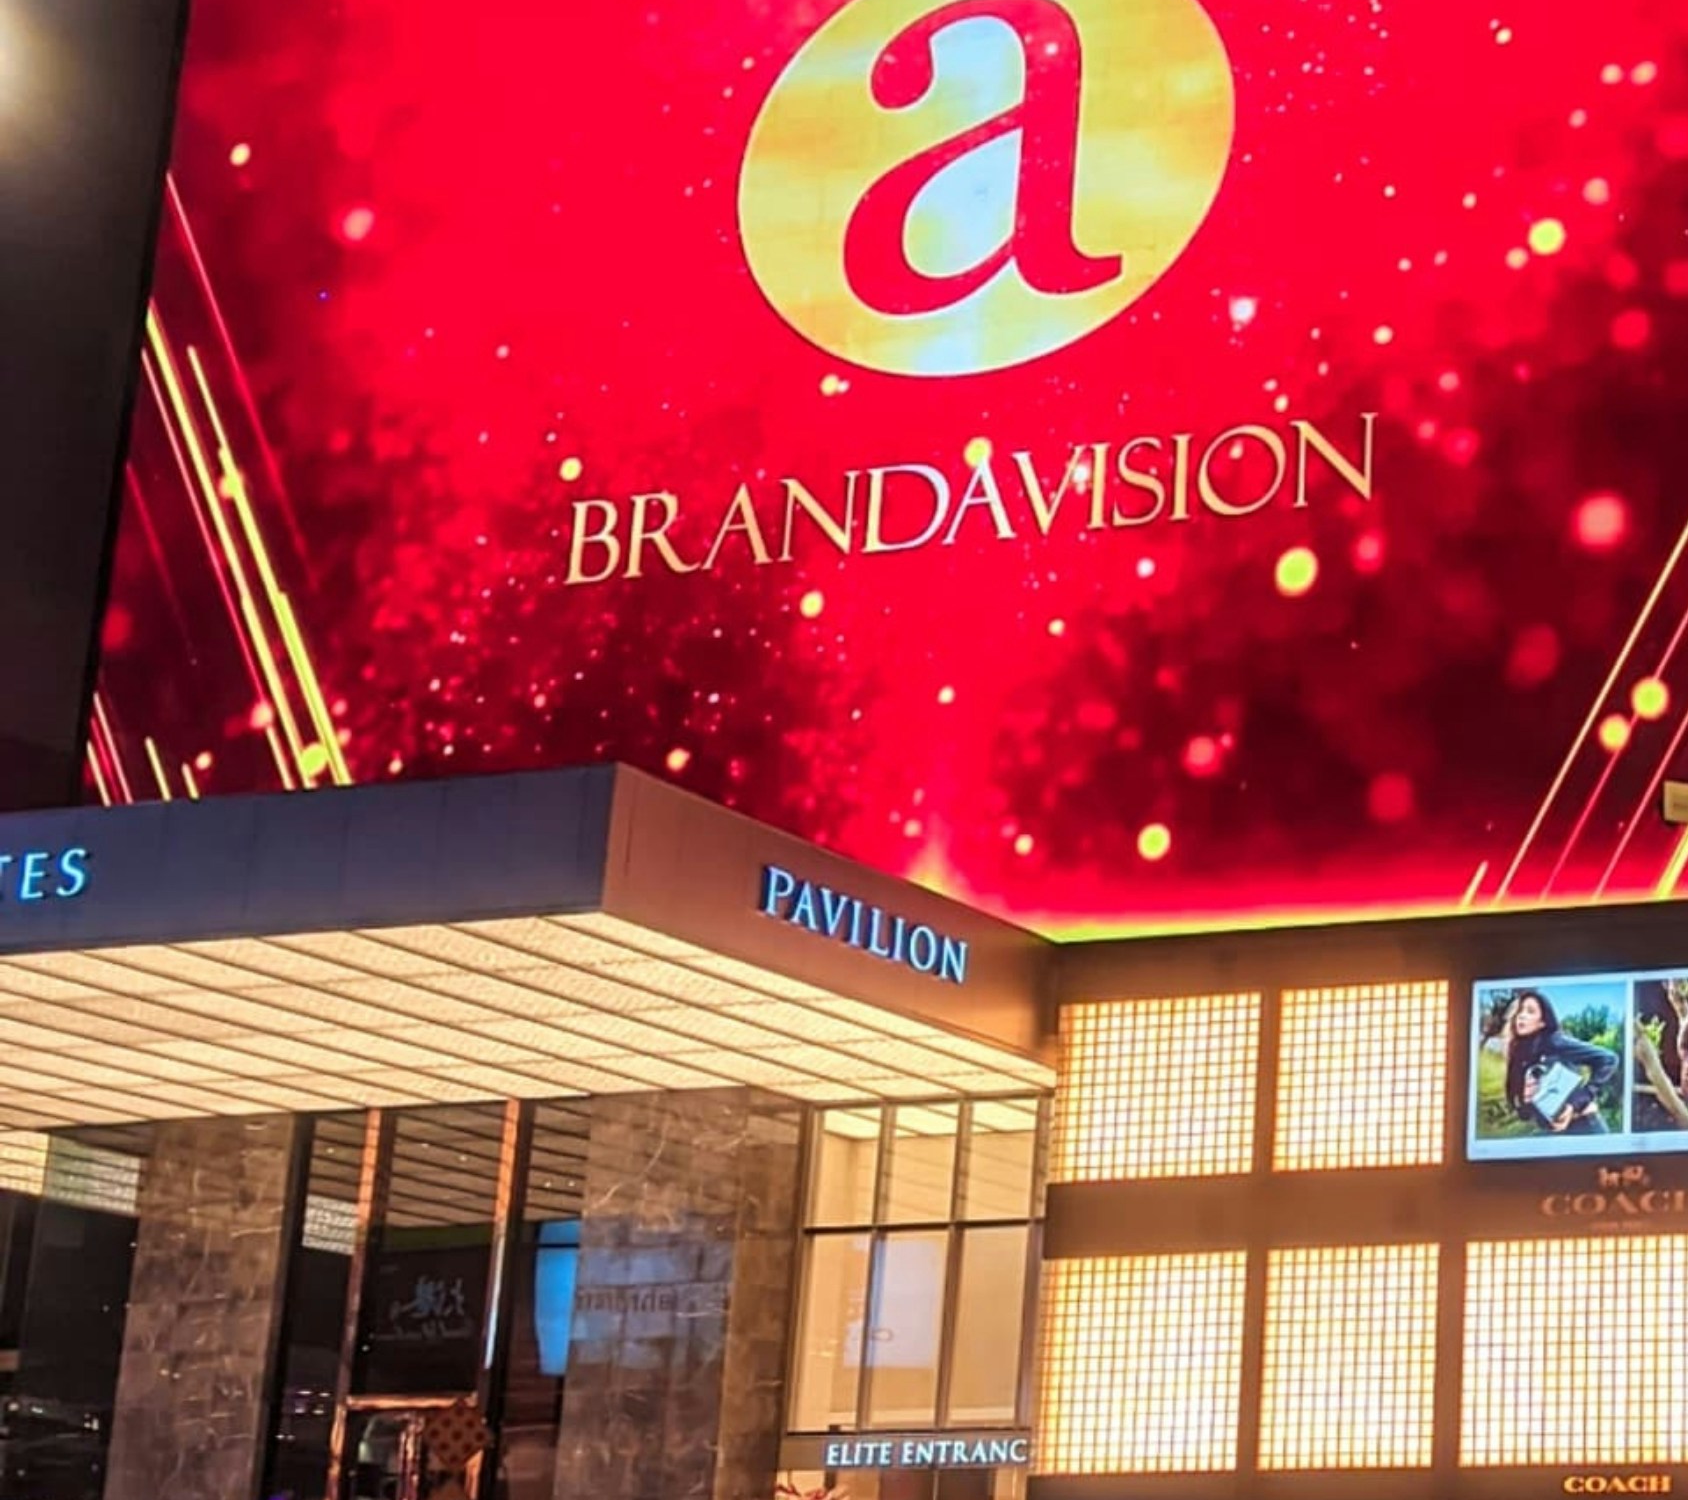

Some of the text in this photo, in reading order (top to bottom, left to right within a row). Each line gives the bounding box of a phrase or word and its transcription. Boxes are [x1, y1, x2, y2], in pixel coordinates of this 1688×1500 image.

[564, 412, 1378, 587] BRANDAVISION
[762, 866, 969, 984] PAVILION
[826, 1438, 1028, 1467] ELITE ENTRANC
[1564, 1475, 1671, 1494] COACH
